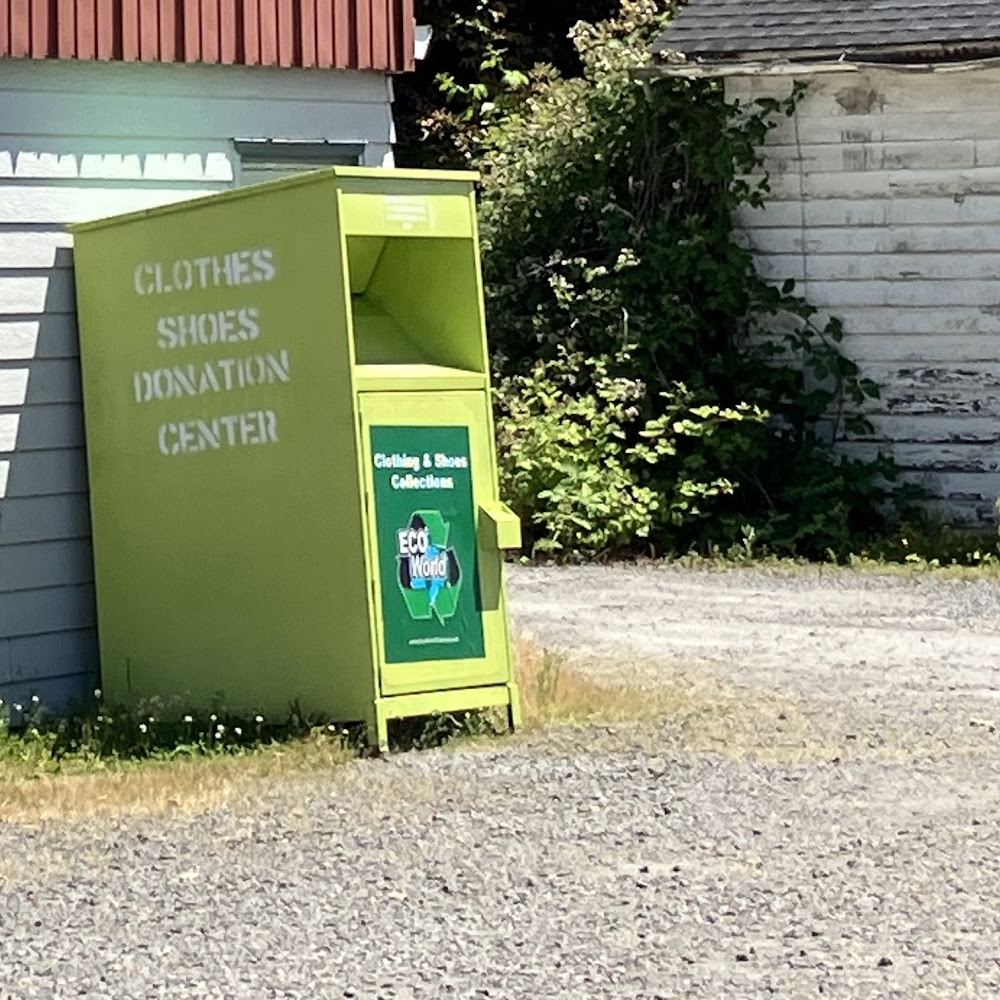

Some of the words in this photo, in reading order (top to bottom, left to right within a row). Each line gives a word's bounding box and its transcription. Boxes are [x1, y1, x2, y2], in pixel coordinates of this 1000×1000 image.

[134, 249, 276, 296] CLOTHES
[157, 307, 260, 349] SHOES
[134, 349, 291, 403] DONATION
[158, 409, 279, 456] CENTER
[373, 452, 420, 472] Clothing
[422, 453, 432, 468] &
[434, 453, 468, 468] Shoes
[391, 474, 454, 489] Collections
[398, 529, 429, 554] ECO
[411, 552, 447, 577] World
